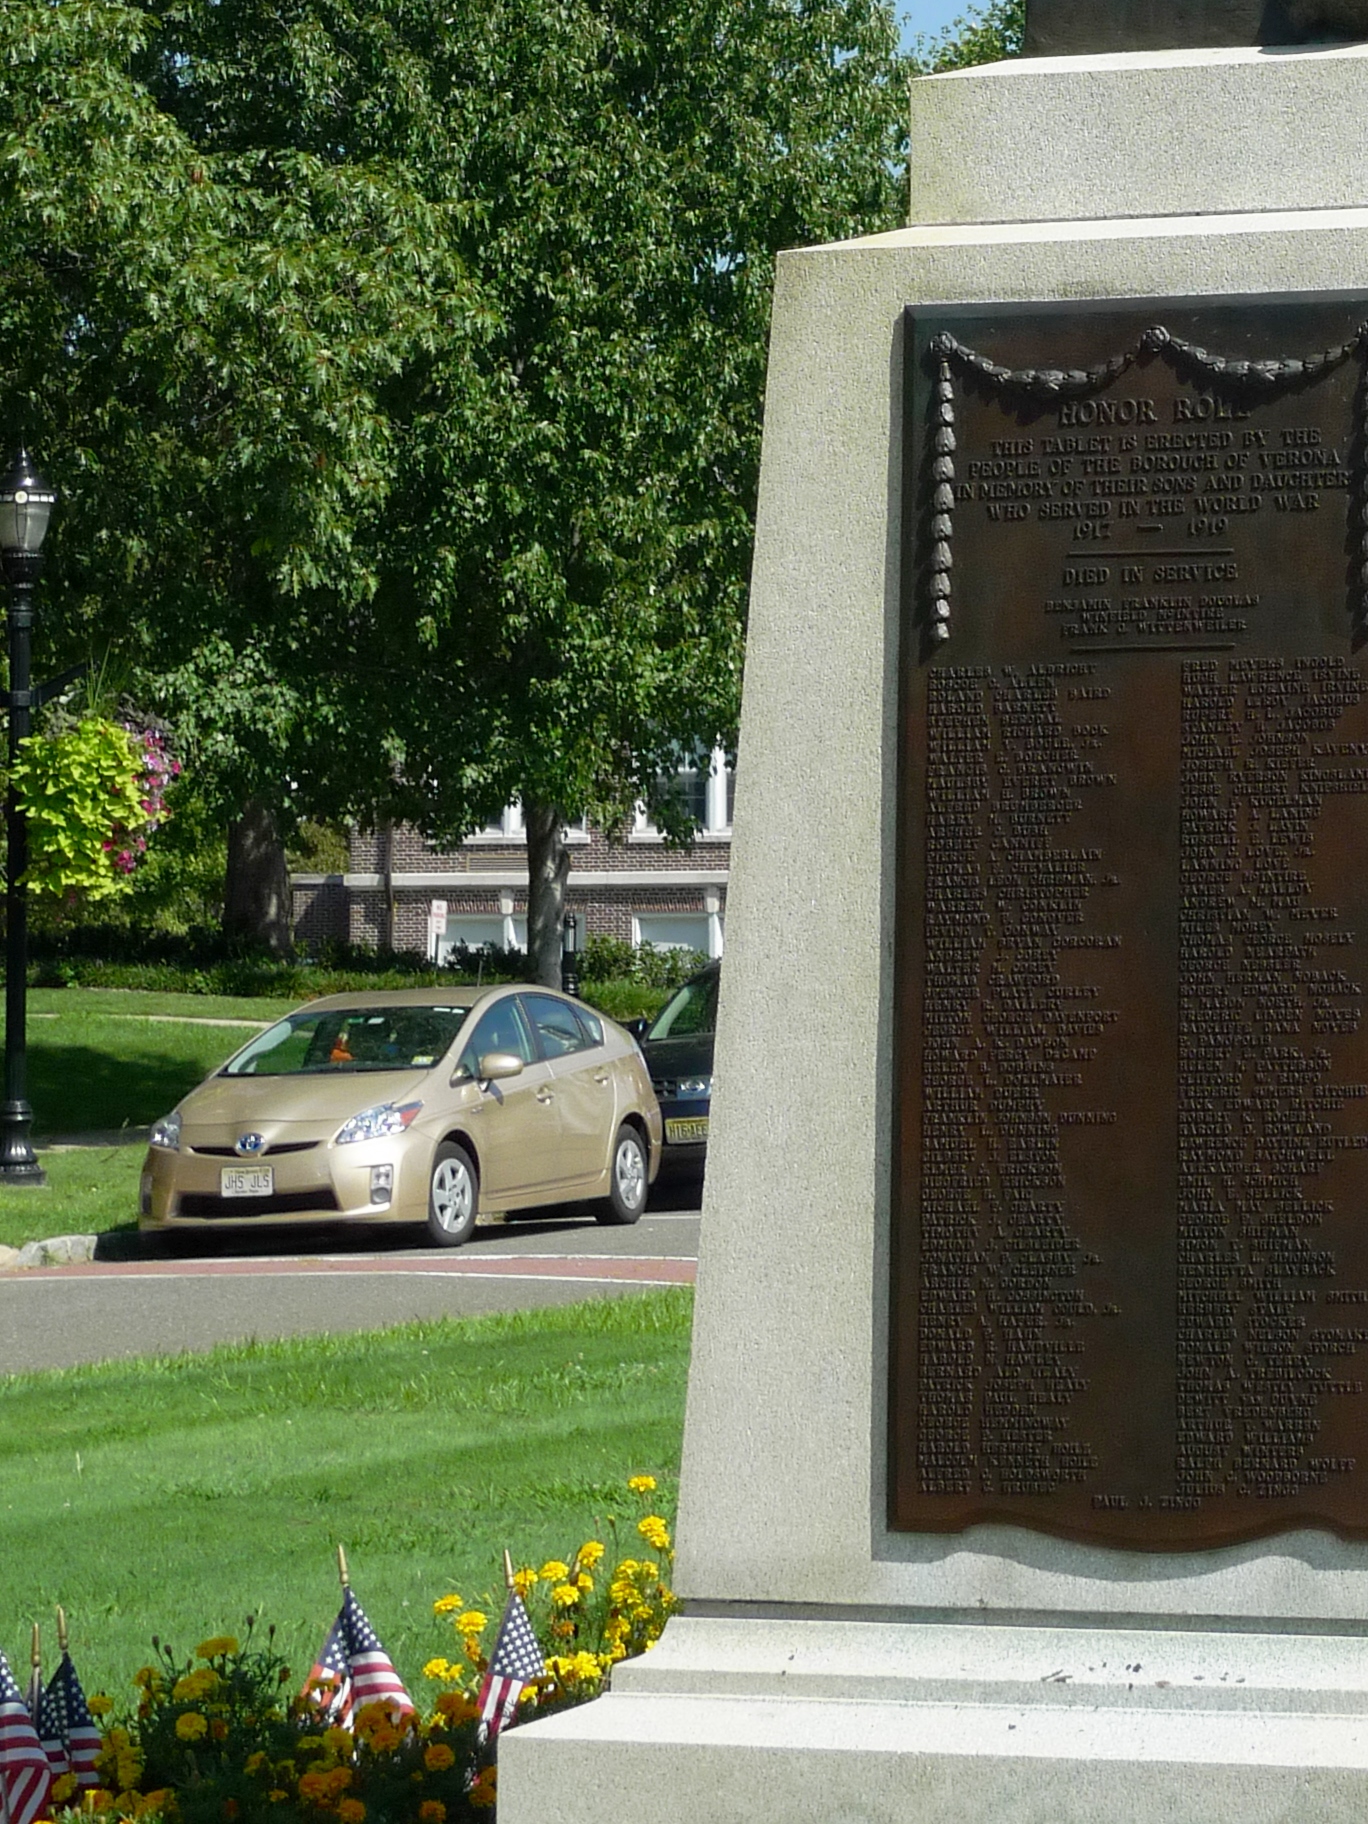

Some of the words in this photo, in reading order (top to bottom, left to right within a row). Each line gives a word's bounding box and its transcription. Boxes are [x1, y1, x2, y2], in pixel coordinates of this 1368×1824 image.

[1060, 399, 1157, 426] HONOR
[990, 439, 1033, 457] THIS
[1041, 435, 1113, 454] TABLET
[1119, 434, 1137, 452] IS
[1145, 431, 1233, 450] ERECTED
[1242, 430, 1271, 448] BY
[1282, 427, 1322, 446] THE
[969, 460, 1041, 478] PEOPLE
[1050, 458, 1074, 475] OF
[1081, 456, 1120, 473] THE
[1131, 453, 1218, 472] BOROUGH
[1224, 452, 1249, 470] OF
[1258, 449, 1341, 468] VERONA
[956, 482, 975, 500] IN
[980, 479, 1059, 499] MEMORY
[1062, 478, 1084, 496] OF
[1092, 476, 1147, 495] THEIR
[1153, 475, 1197, 493] SONS
[1205, 474, 1244, 492] AND
[988, 504, 1031, 521] WHO
[1040, 500, 1111, 519] SERVED
[1119, 500, 1140, 517] IN
[1146, 498, 1184, 515] THE
[1194, 496, 1261, 514] WORLD
[1275, 493, 1320, 511] WAR
[1074, 520, 1114, 539] 1917
[1189, 518, 1229, 536] 1919
[1064, 566, 1110, 585] DIED
[1122, 566, 1144, 583] IN
[1153, 563, 1239, 582] SERVICE
[225, 1174, 244, 1189] JHS
[251, 1173, 270, 1188] JLS
